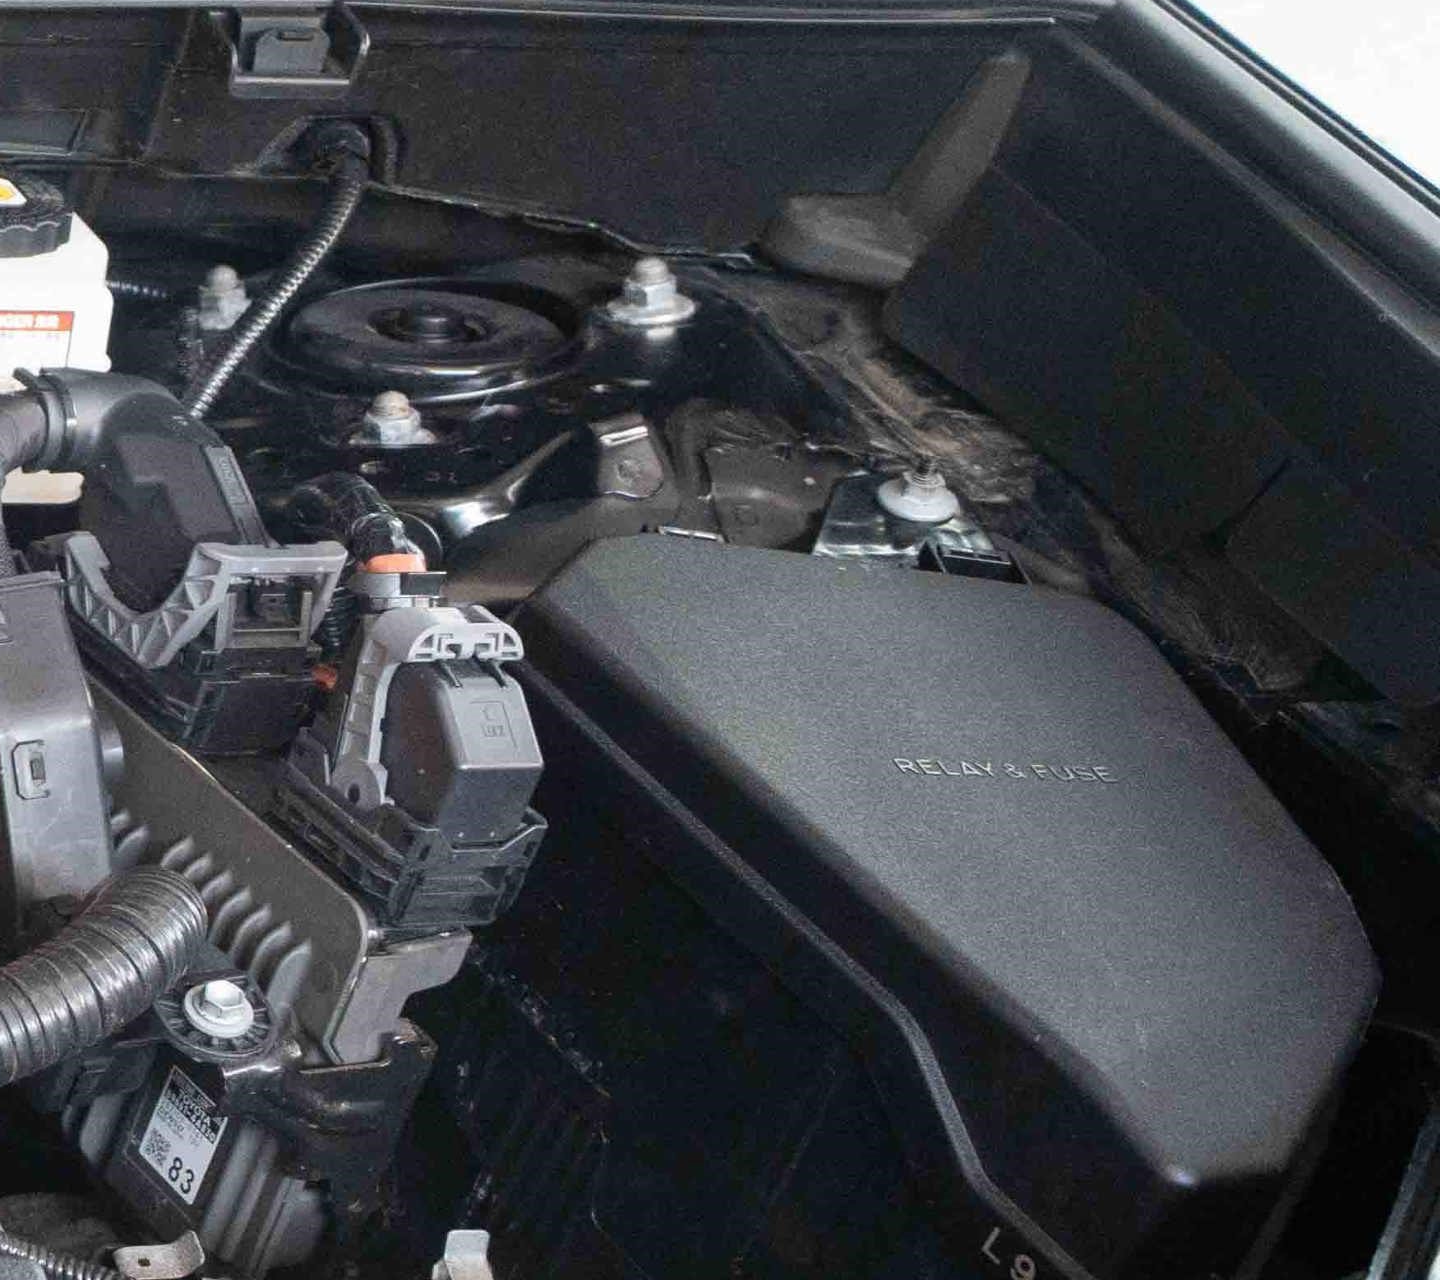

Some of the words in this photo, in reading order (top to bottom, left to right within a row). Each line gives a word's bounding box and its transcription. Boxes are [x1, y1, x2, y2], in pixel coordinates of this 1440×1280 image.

[892, 757, 994, 777] RELAY
[1003, 760, 1027, 779] &
[1030, 764, 1118, 783] FUSE
[177, 1089, 212, 1127] TOYOTA
[168, 1156, 194, 1194] 83
